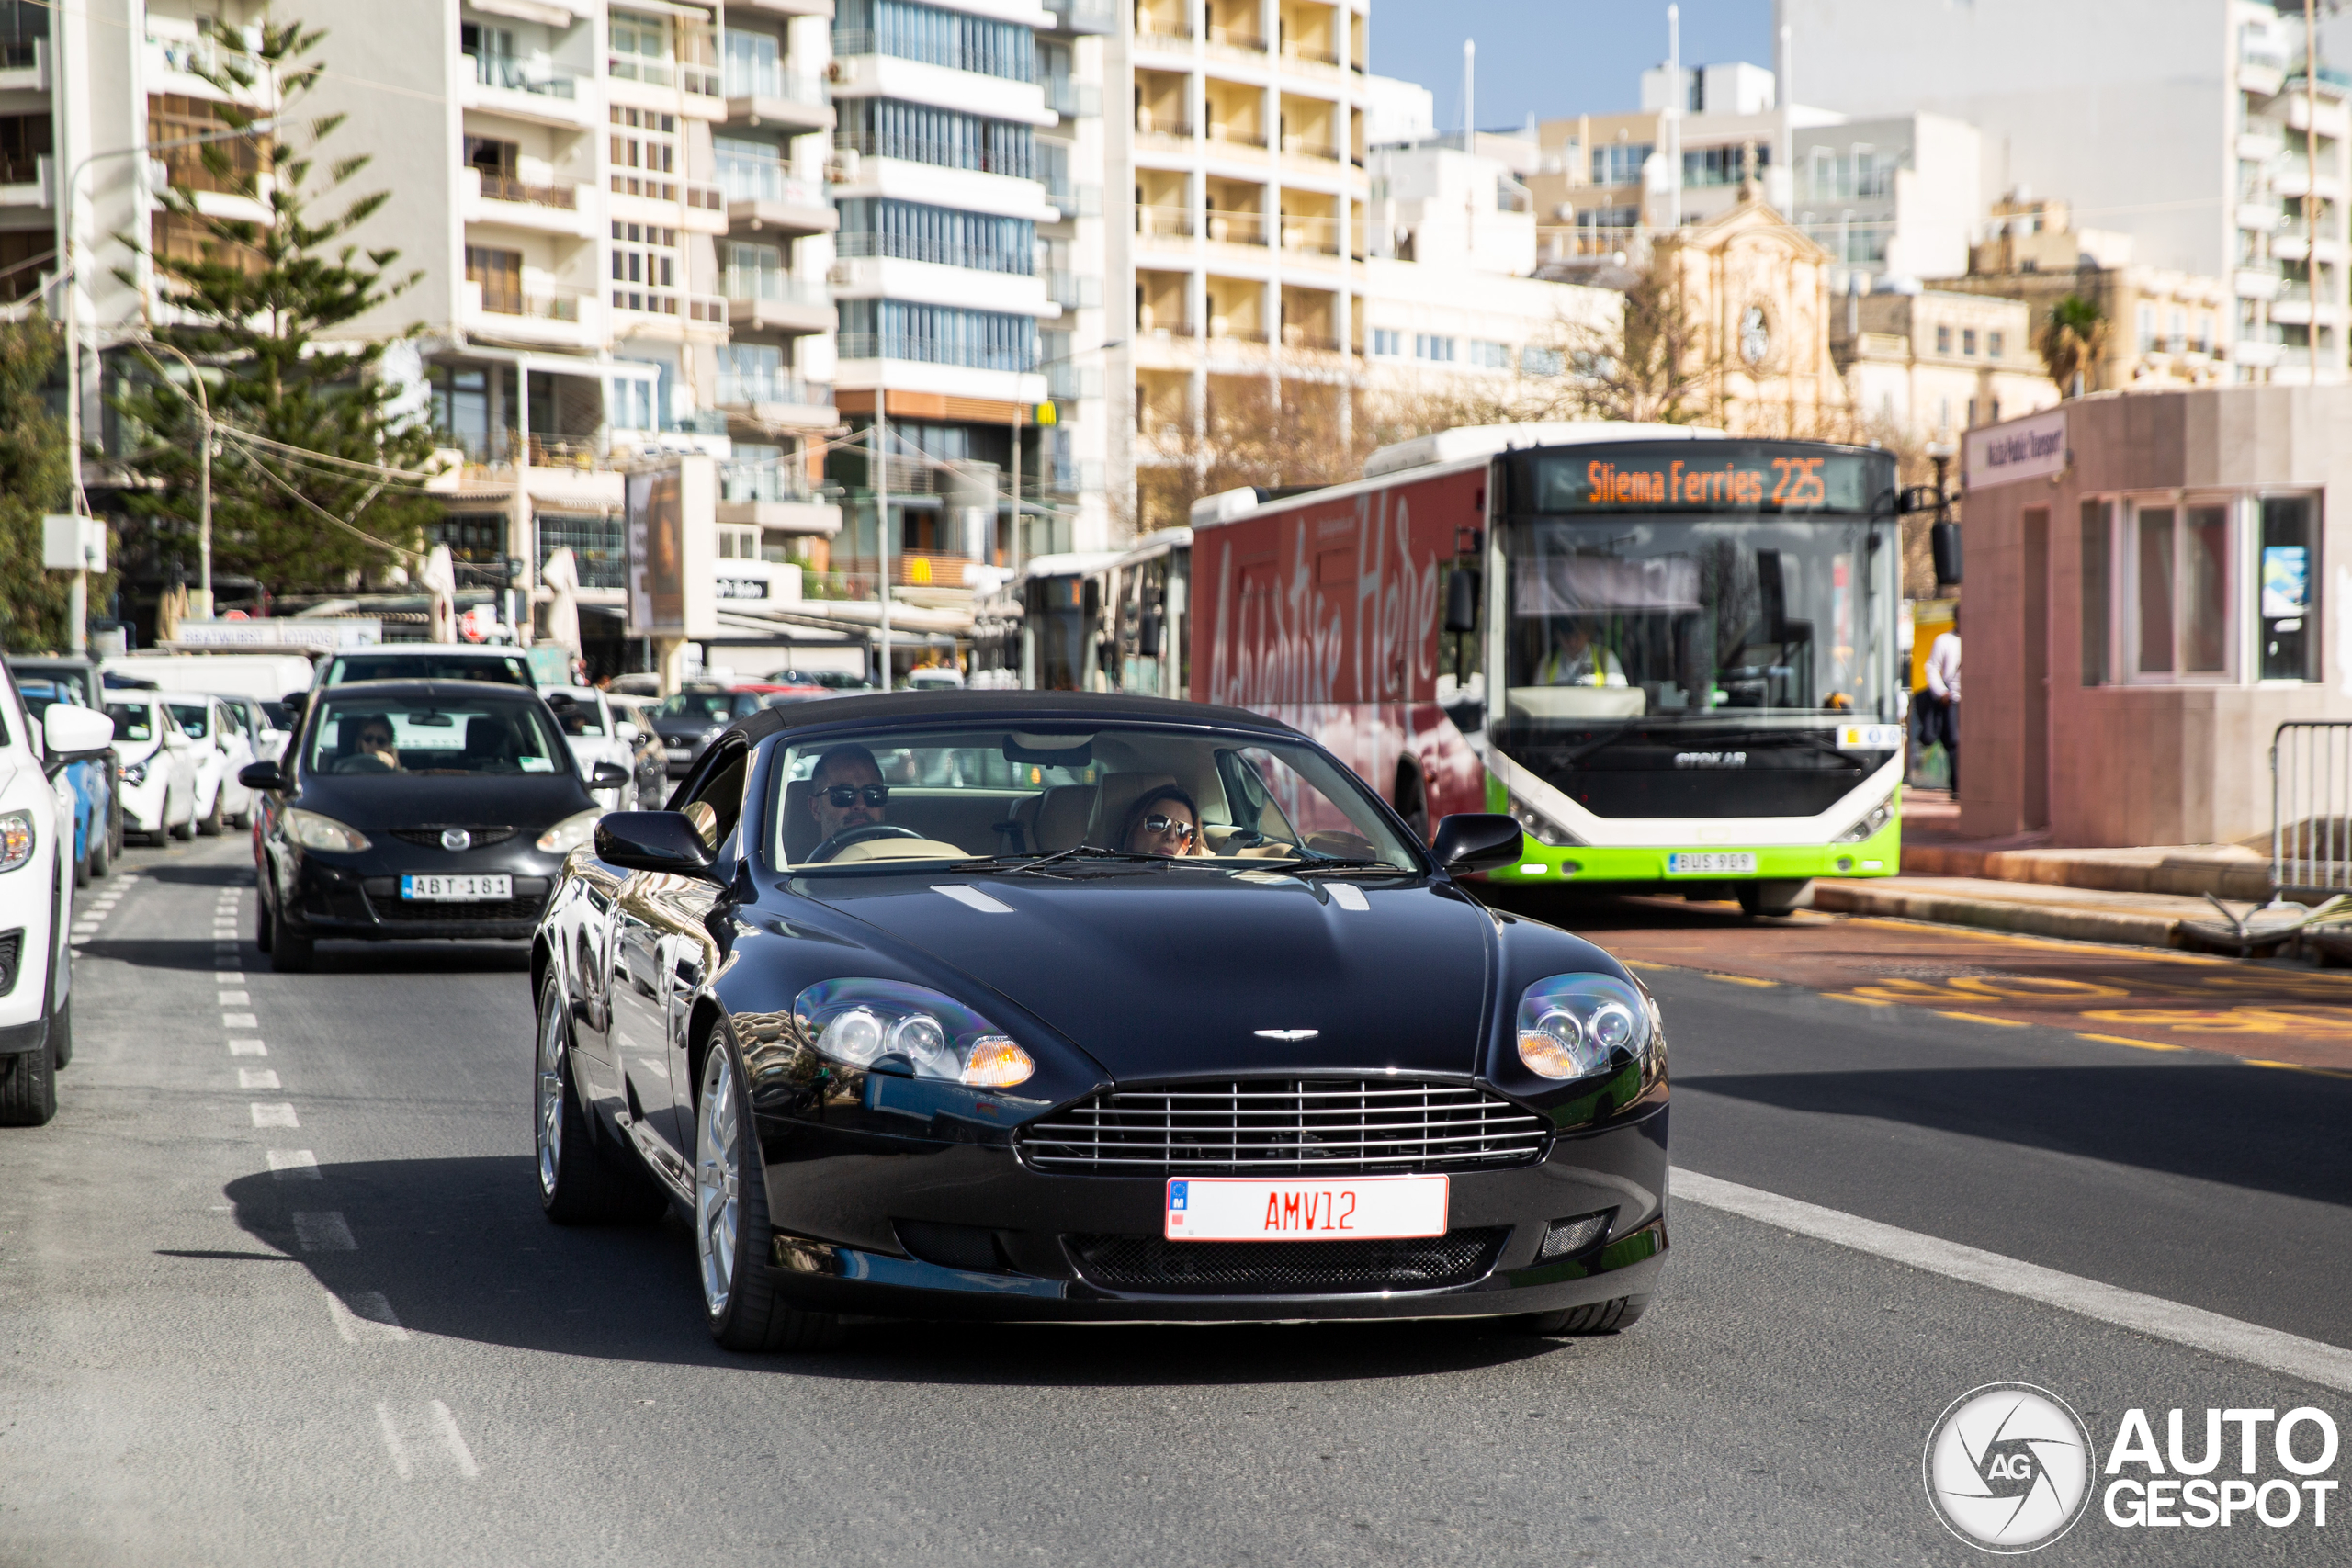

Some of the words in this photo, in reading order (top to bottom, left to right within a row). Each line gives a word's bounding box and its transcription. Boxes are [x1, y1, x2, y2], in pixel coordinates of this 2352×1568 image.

[1588, 460, 1665, 503] Sliema
[1670, 460, 1762, 503] Ferries
[1771, 457, 1825, 504] 225
[1674, 752, 1747, 769] OTOKAR
[1679, 853, 1712, 869] BUS
[416, 877, 455, 894] ABT
[466, 877, 506, 894] 181
[1264, 1191, 1356, 1231] AMV12
